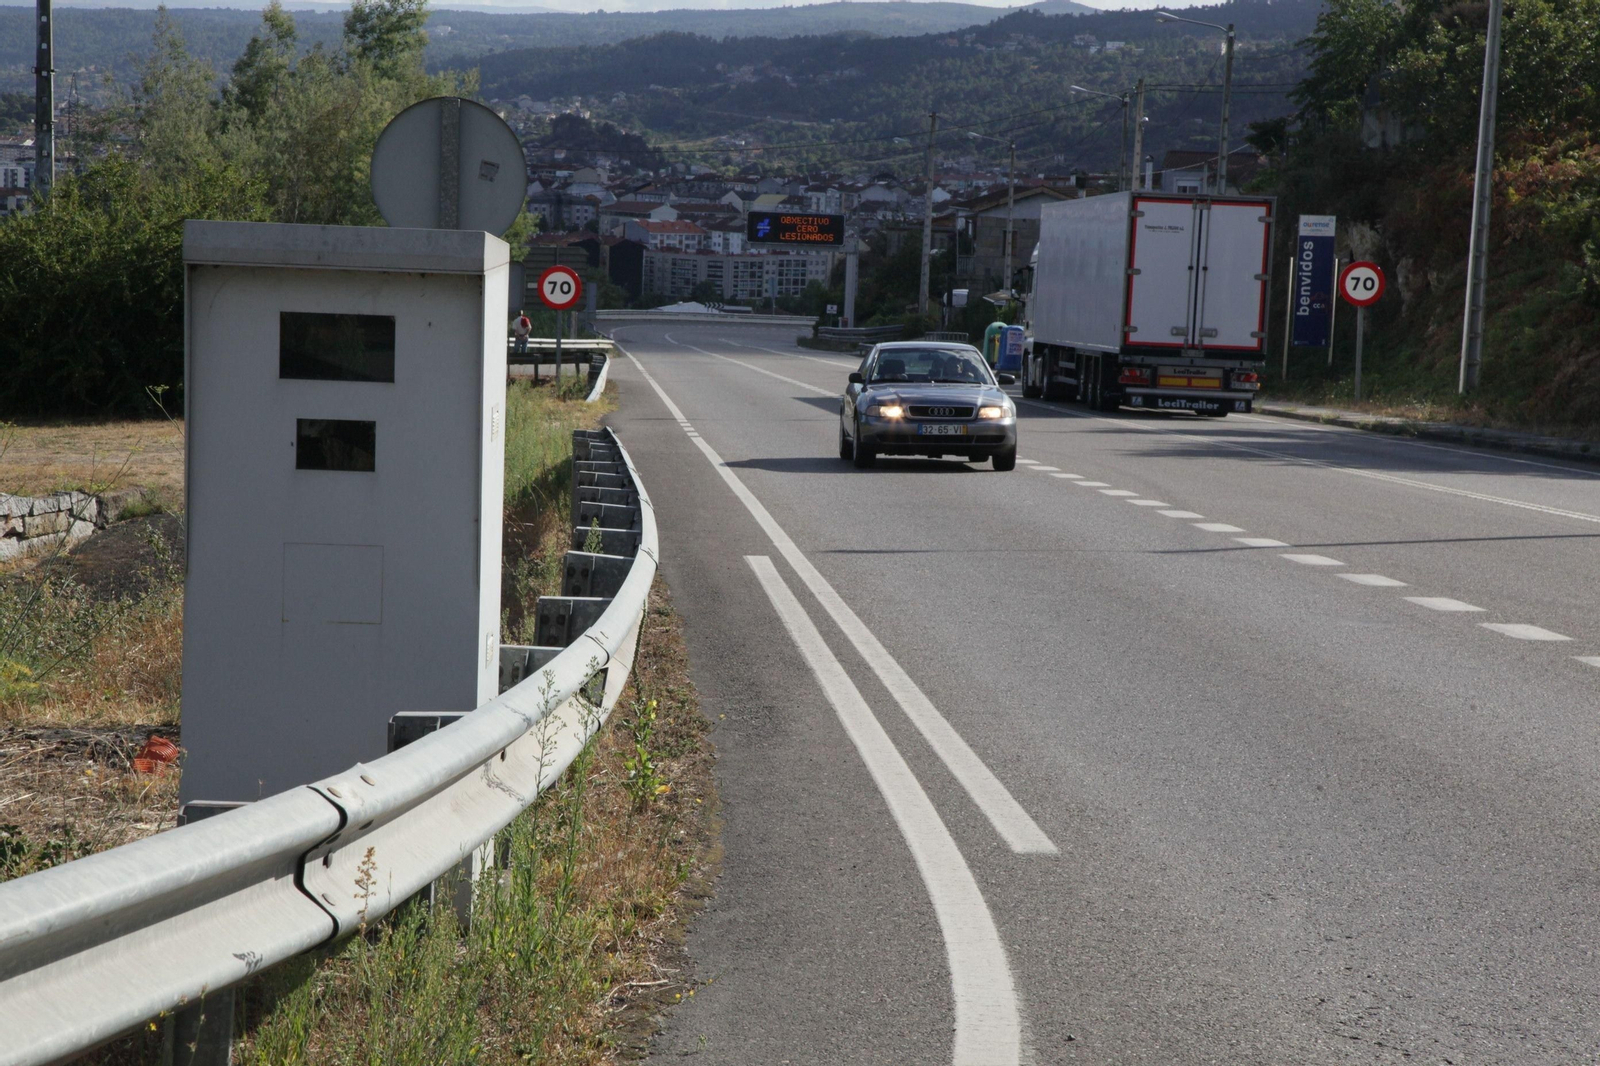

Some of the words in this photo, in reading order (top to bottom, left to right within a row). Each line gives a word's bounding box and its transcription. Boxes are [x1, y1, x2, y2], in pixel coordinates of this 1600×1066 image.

[781, 217, 829, 225] OBXECTIVO
[796, 225, 819, 233] CERO
[780, 233, 834, 242] LESIONADOS
[1297, 241, 1314, 316] benvidos
[1351, 276, 1375, 291] 70
[548, 280, 572, 295] 70
[1158, 398, 1219, 409] LeciTrailer
